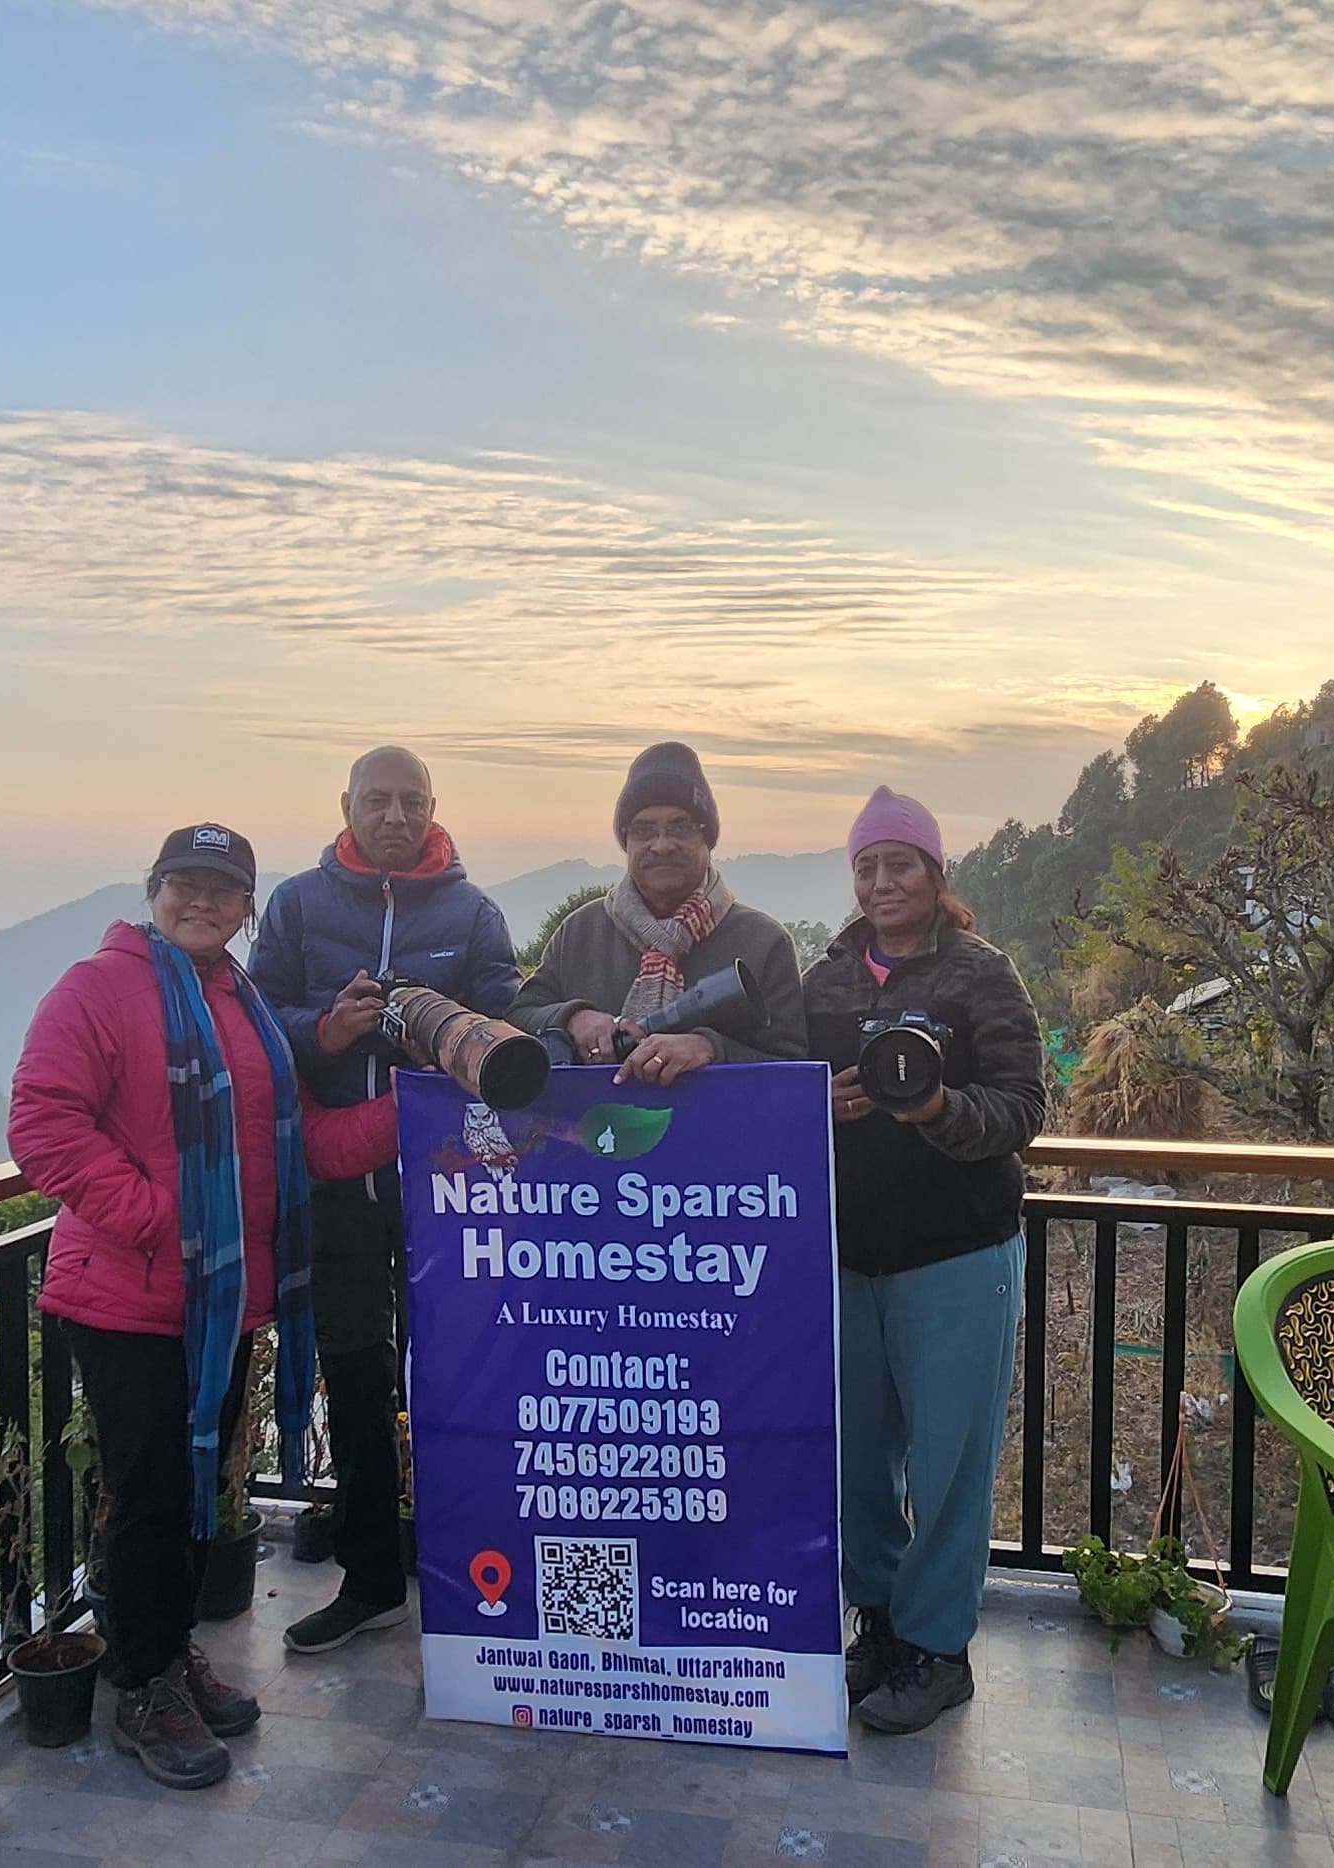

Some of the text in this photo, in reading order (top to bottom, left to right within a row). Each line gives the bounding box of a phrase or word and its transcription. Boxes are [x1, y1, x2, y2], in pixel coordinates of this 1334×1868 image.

[197, 830, 227, 843] OM
[431, 1172, 798, 1228] Nature Sparsh
[462, 1227, 768, 1297] Homestay
[496, 1302, 738, 1337] A Luxury Homestay
[546, 1349, 690, 1390] Contact:
[518, 1395, 721, 1436] 8077509193
[514, 1440, 727, 1480] 7456922805
[516, 1484, 728, 1523] 7088225369
[651, 1576, 798, 1606] Scan here for
[681, 1606, 769, 1633] location
[476, 1646, 543, 1668] Jantwal
[548, 1650, 596, 1672] Gaon,
[677, 1657, 785, 1679] Uttarakhand
[493, 1675, 769, 1708] www.naturesparshhomestay.com
[539, 1708, 753, 1739] nature_sparsh_homestay
